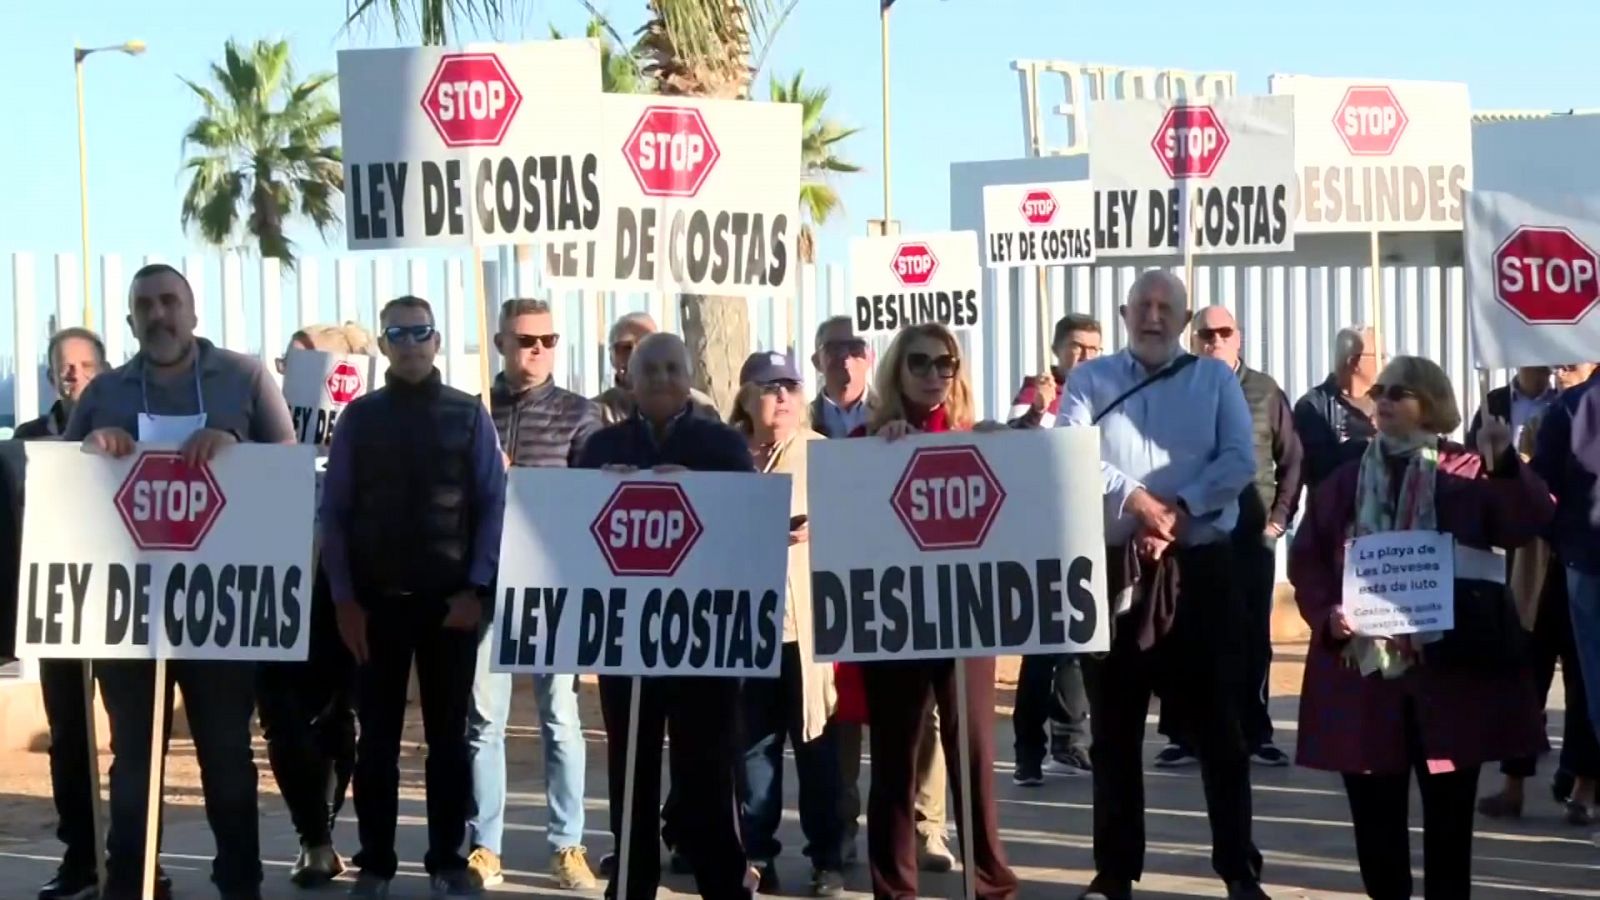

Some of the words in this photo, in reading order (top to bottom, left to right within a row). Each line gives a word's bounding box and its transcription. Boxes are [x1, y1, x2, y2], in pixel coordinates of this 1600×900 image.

[438, 80, 505, 121] STOP
[1344, 106, 1396, 136] STOP
[639, 131, 705, 171] STOP
[1164, 127, 1216, 159] STOP
[350, 161, 408, 239] LEY
[421, 159, 464, 236] DE
[476, 153, 600, 234] COSTAS
[1024, 199, 1054, 217] STOP
[1094, 190, 1138, 249] LEY
[1148, 188, 1180, 248] DE
[1190, 184, 1287, 247] COSTAS
[615, 205, 656, 280] DE
[669, 208, 787, 287] COSTAS
[897, 254, 932, 276] STOP
[990, 232, 1014, 263] LEY
[1019, 231, 1036, 260] DE
[1041, 228, 1092, 259] COSTAS
[1501, 256, 1594, 293] STOP
[856, 289, 979, 332] DESLINDES
[133, 480, 208, 521] STOP
[910, 475, 986, 521] STOP
[610, 509, 684, 548] STOP
[1360, 549, 1375, 560] La
[1378, 547, 1414, 560] playa
[1417, 545, 1437, 554] de
[1390, 580, 1407, 592] de
[1410, 579, 1438, 591] luto
[26, 562, 93, 645] LEY
[105, 562, 151, 646] DE
[164, 562, 302, 650] COSTAS
[813, 556, 1098, 656] DESLINDES
[499, 587, 568, 665] LEY
[577, 587, 627, 667] DE
[639, 587, 779, 670] COSTAS
